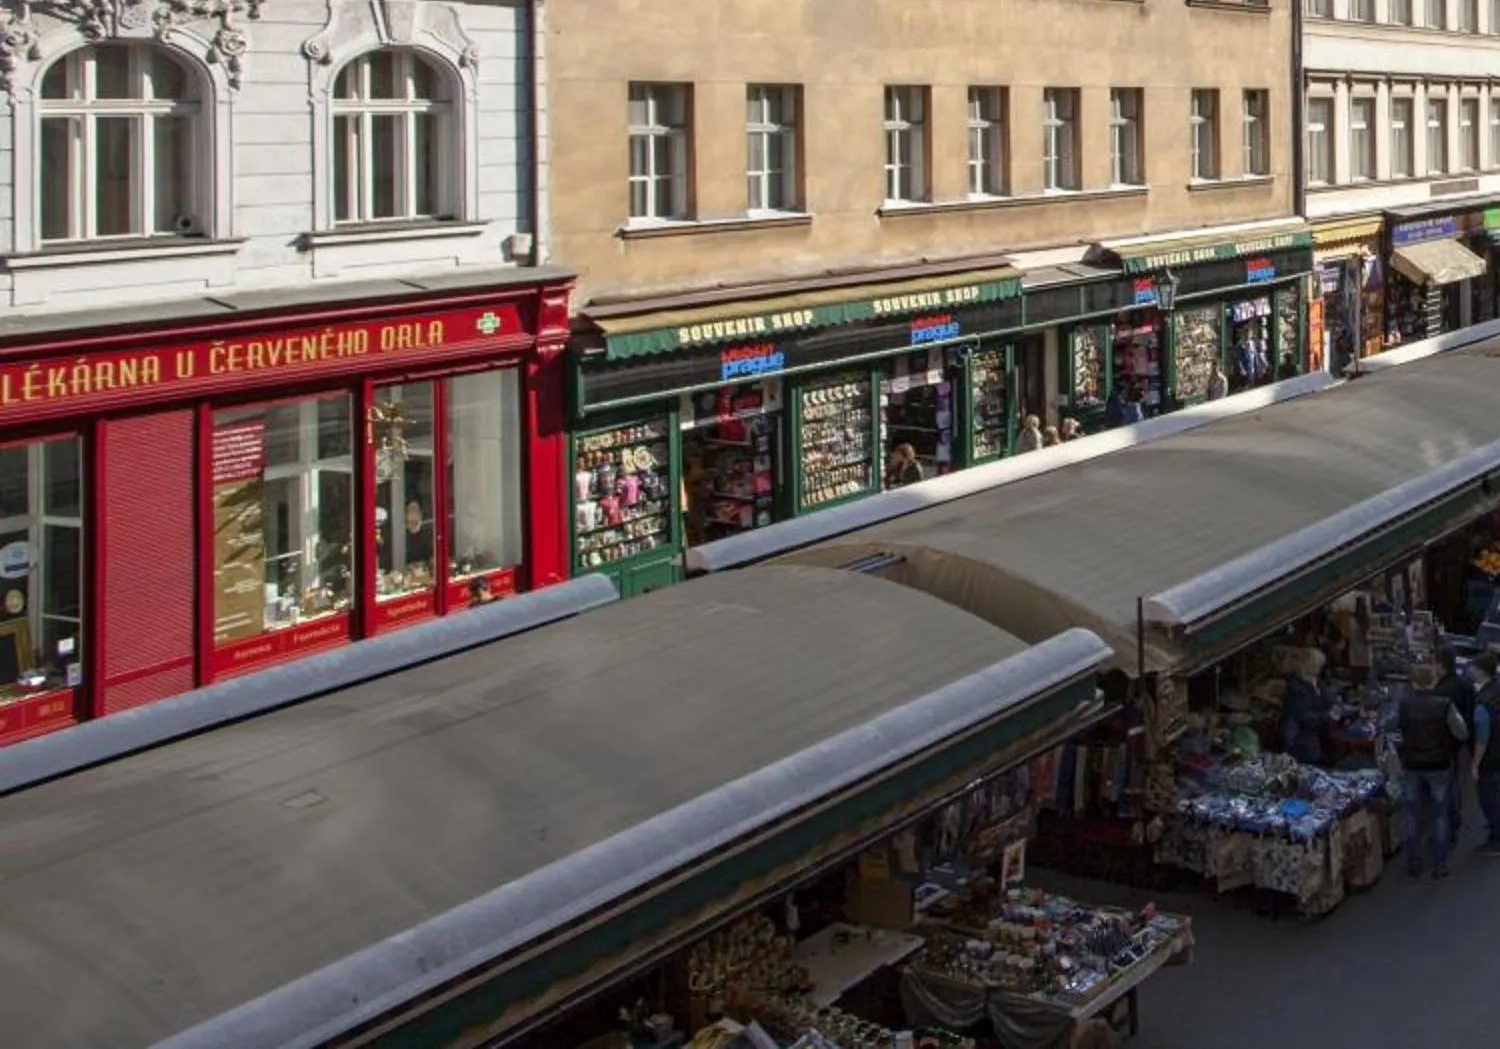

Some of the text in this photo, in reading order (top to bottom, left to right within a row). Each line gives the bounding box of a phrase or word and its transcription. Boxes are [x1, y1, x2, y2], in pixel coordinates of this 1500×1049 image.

[873, 286, 979, 314] SOUVENIR SHOP
[679, 309, 813, 344] SOUVENIR SHOP
[2, 320, 444, 402] LÉKÁRNA U ČERVENÉHO ORLA
[721, 351, 785, 381] prague
